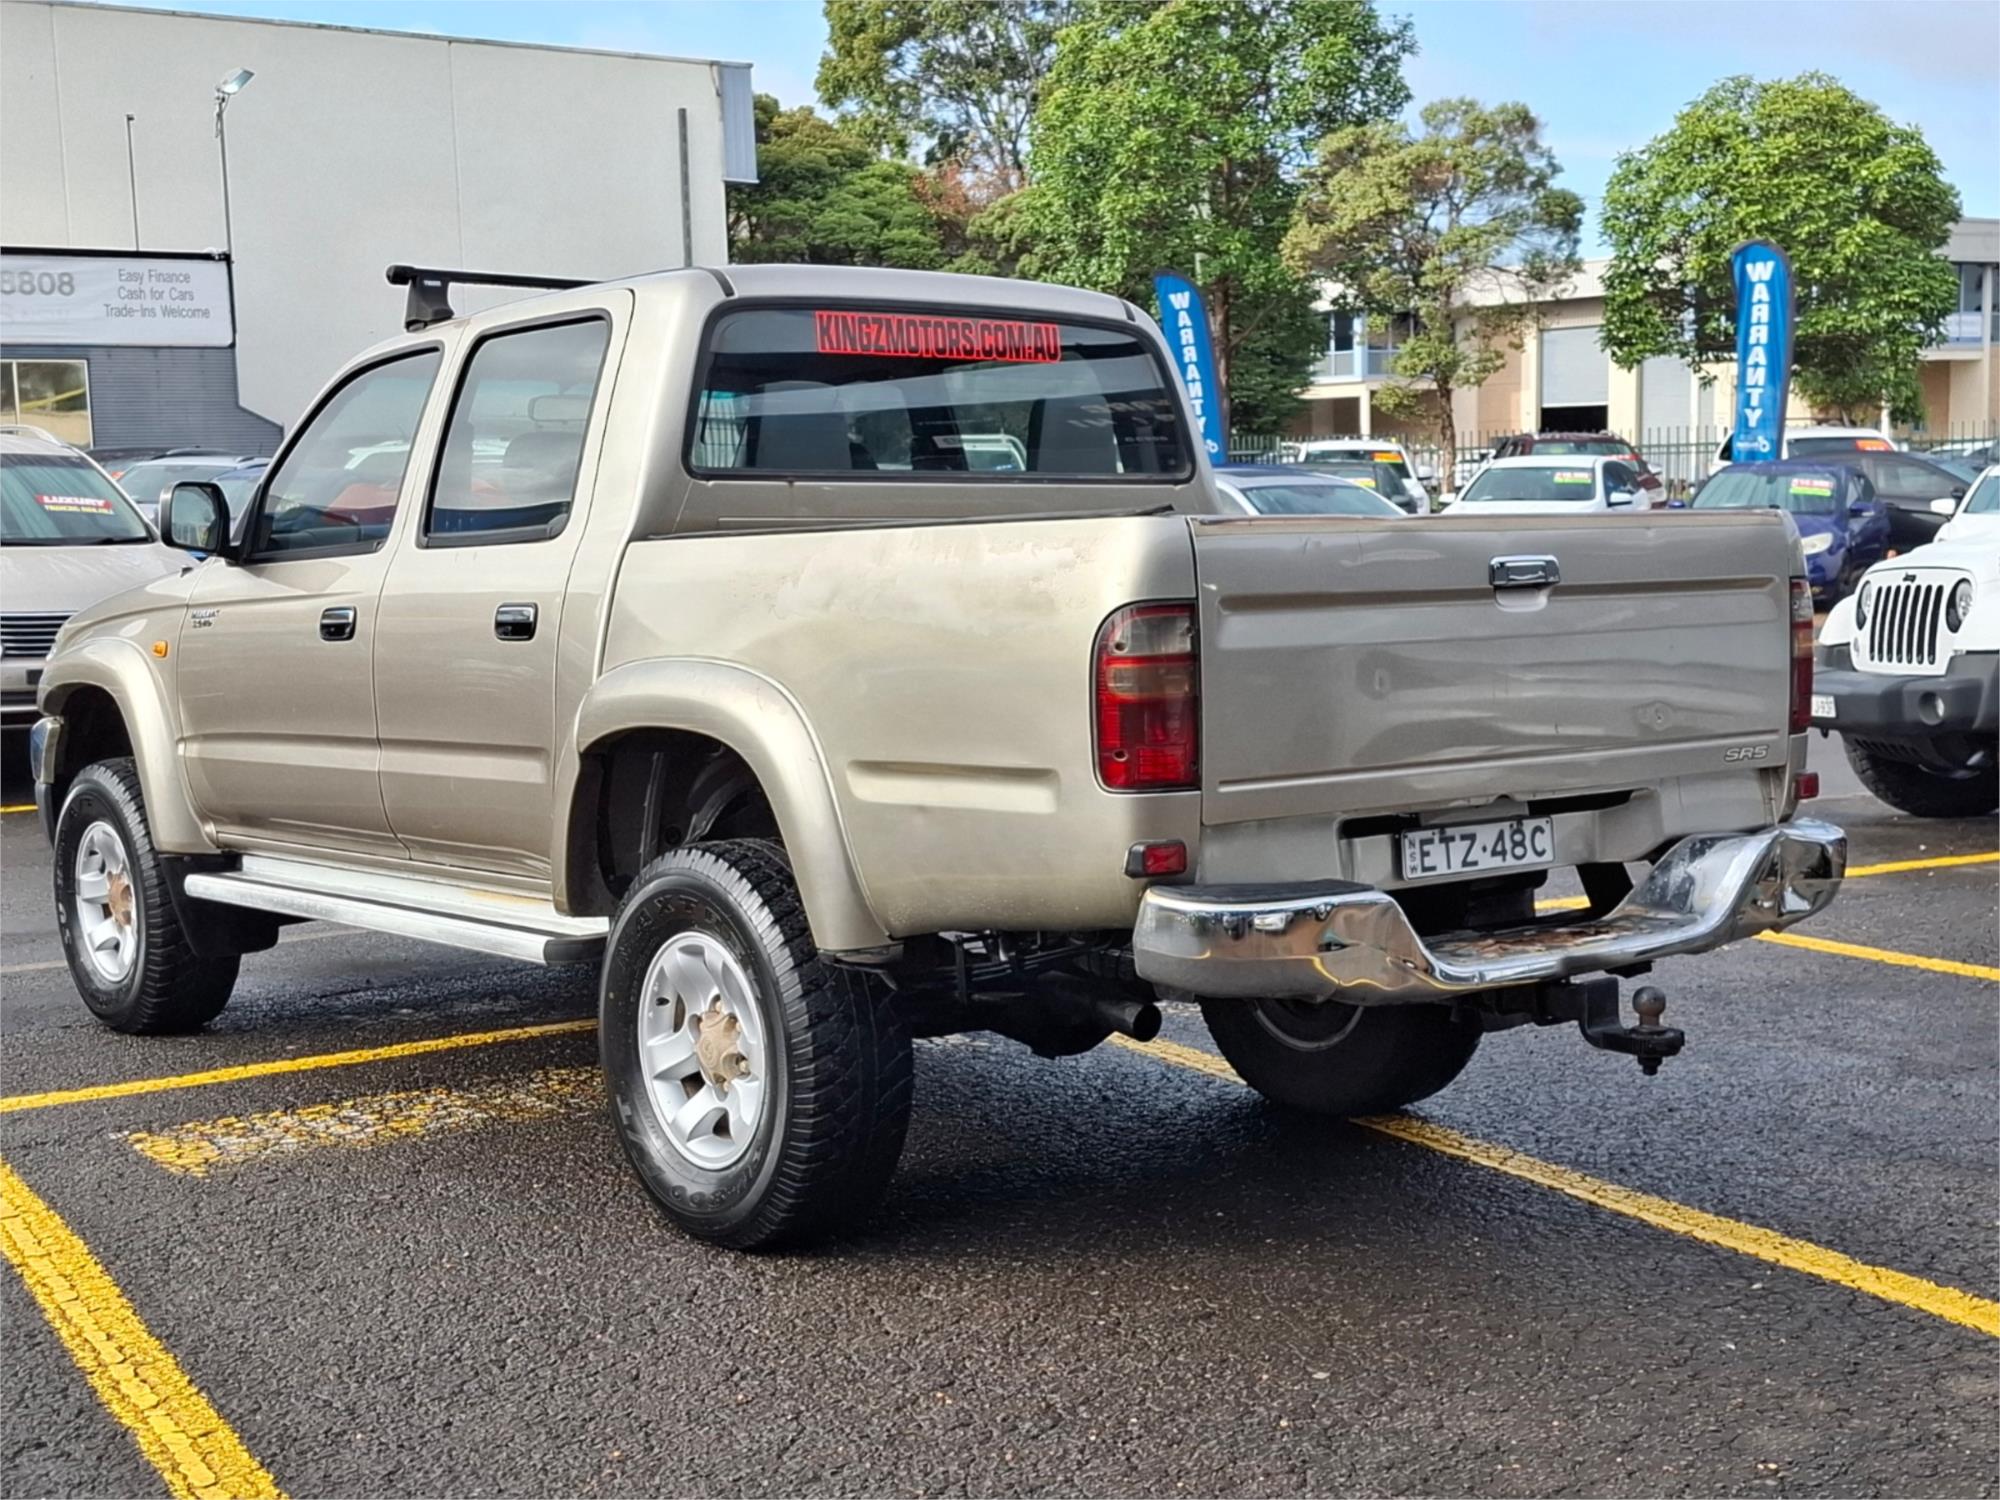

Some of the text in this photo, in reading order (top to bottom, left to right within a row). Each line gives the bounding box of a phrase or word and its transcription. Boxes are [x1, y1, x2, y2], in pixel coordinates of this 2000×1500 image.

[118, 268, 191, 285] Easy Finance
[118, 286, 194, 301] Cash for Cars
[103, 303, 210, 319] Trade-Ins Welcome
[817, 313, 1059, 361] KINGZMOTORS.COM.AU
[1724, 744, 1769, 762] SR5
